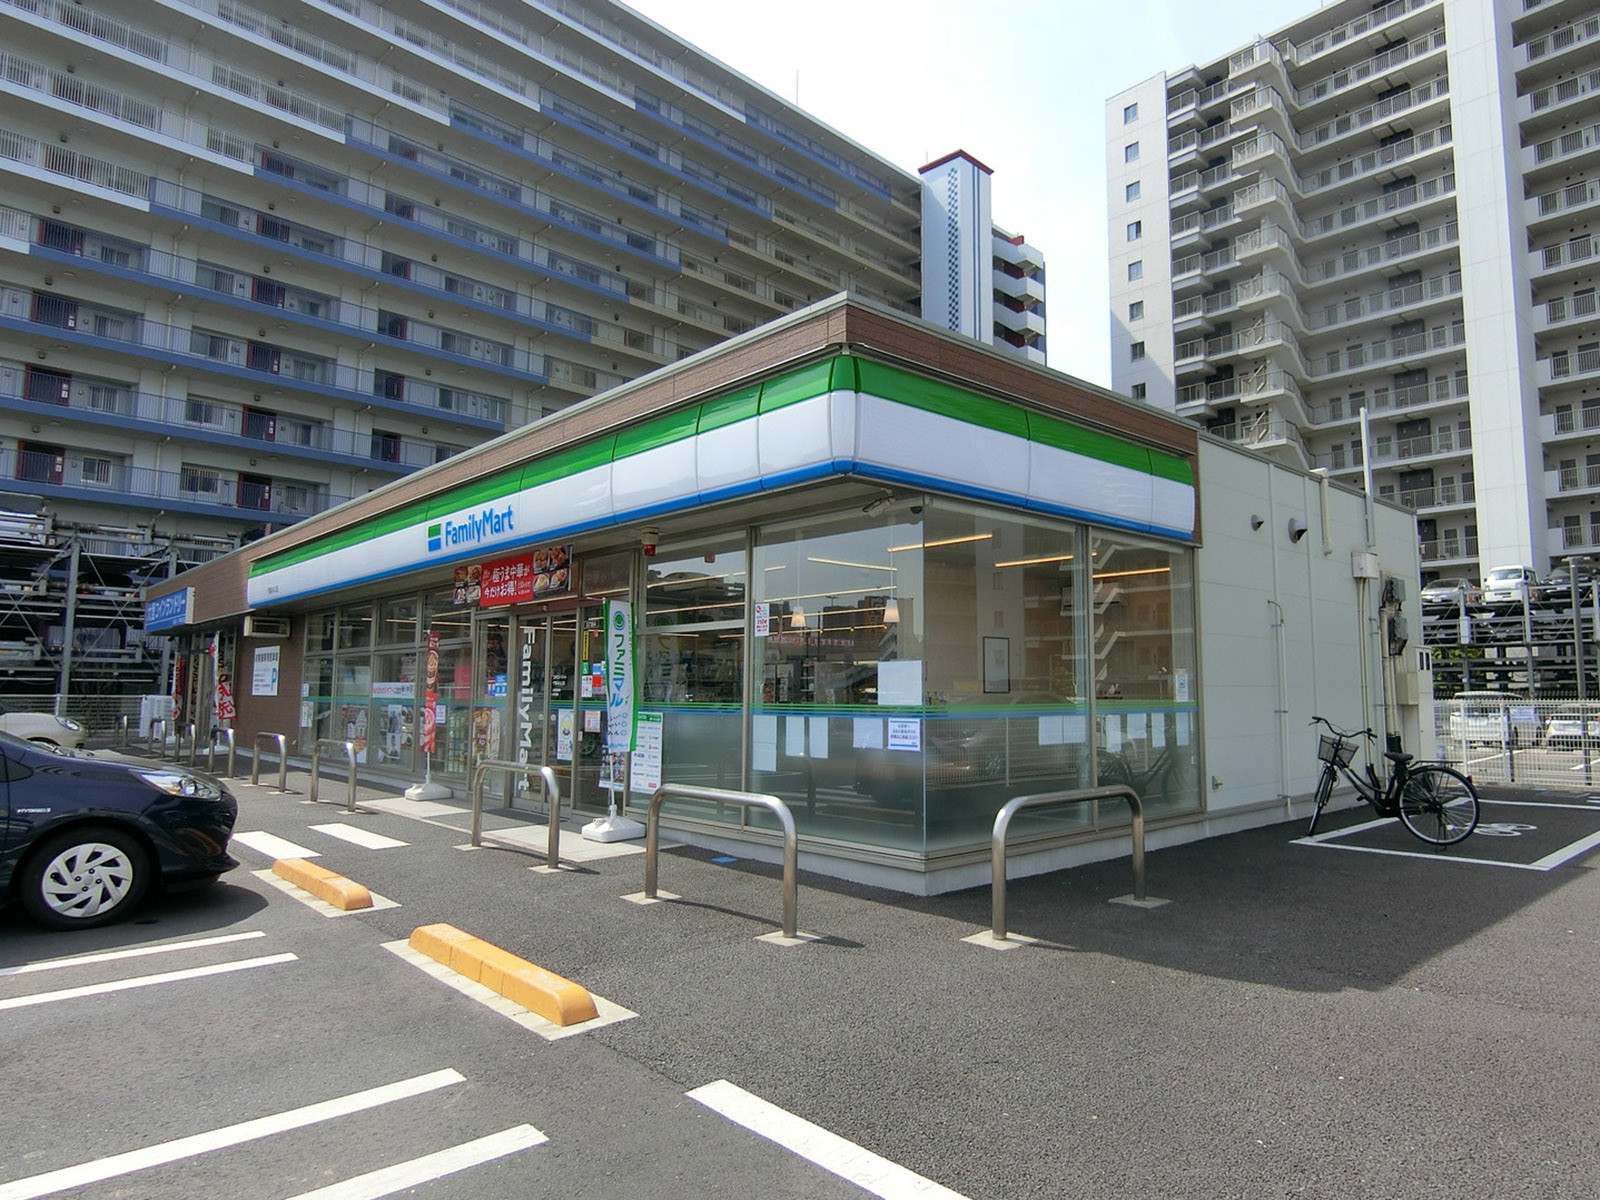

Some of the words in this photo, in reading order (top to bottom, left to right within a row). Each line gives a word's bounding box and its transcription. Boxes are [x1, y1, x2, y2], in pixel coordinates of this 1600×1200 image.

[445, 505, 514, 547] FamilyMart
[610, 634, 626, 707] ファミマル
